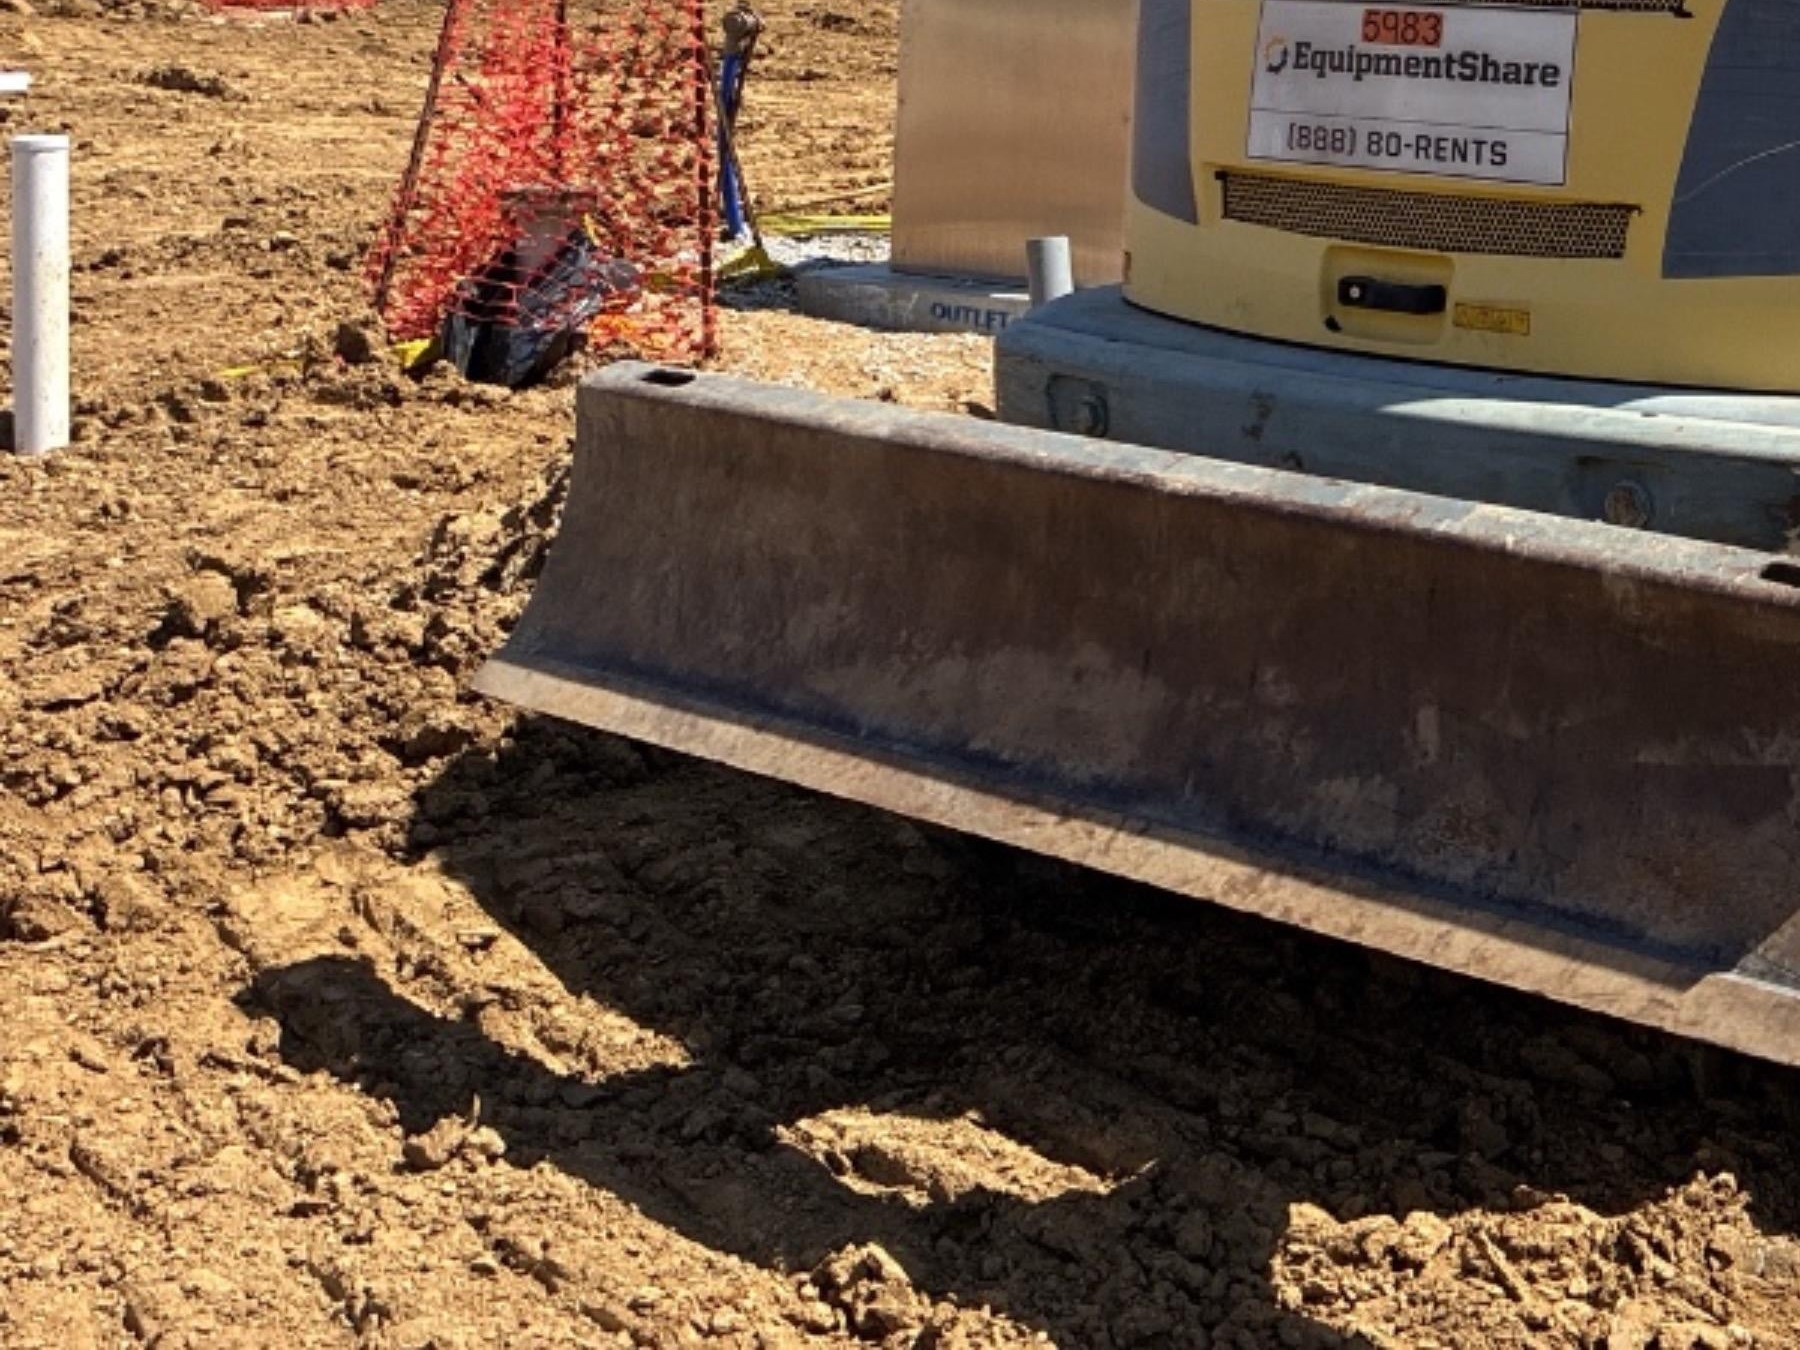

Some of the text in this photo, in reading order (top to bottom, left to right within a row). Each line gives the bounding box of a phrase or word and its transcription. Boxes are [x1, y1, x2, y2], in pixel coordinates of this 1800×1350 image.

[1363, 9, 1442, 46] 5983
[1293, 41, 1561, 88] EquipmentShare
[1286, 122, 1509, 167] (888) 80-RENTS
[931, 301, 1008, 330] OUTLET
